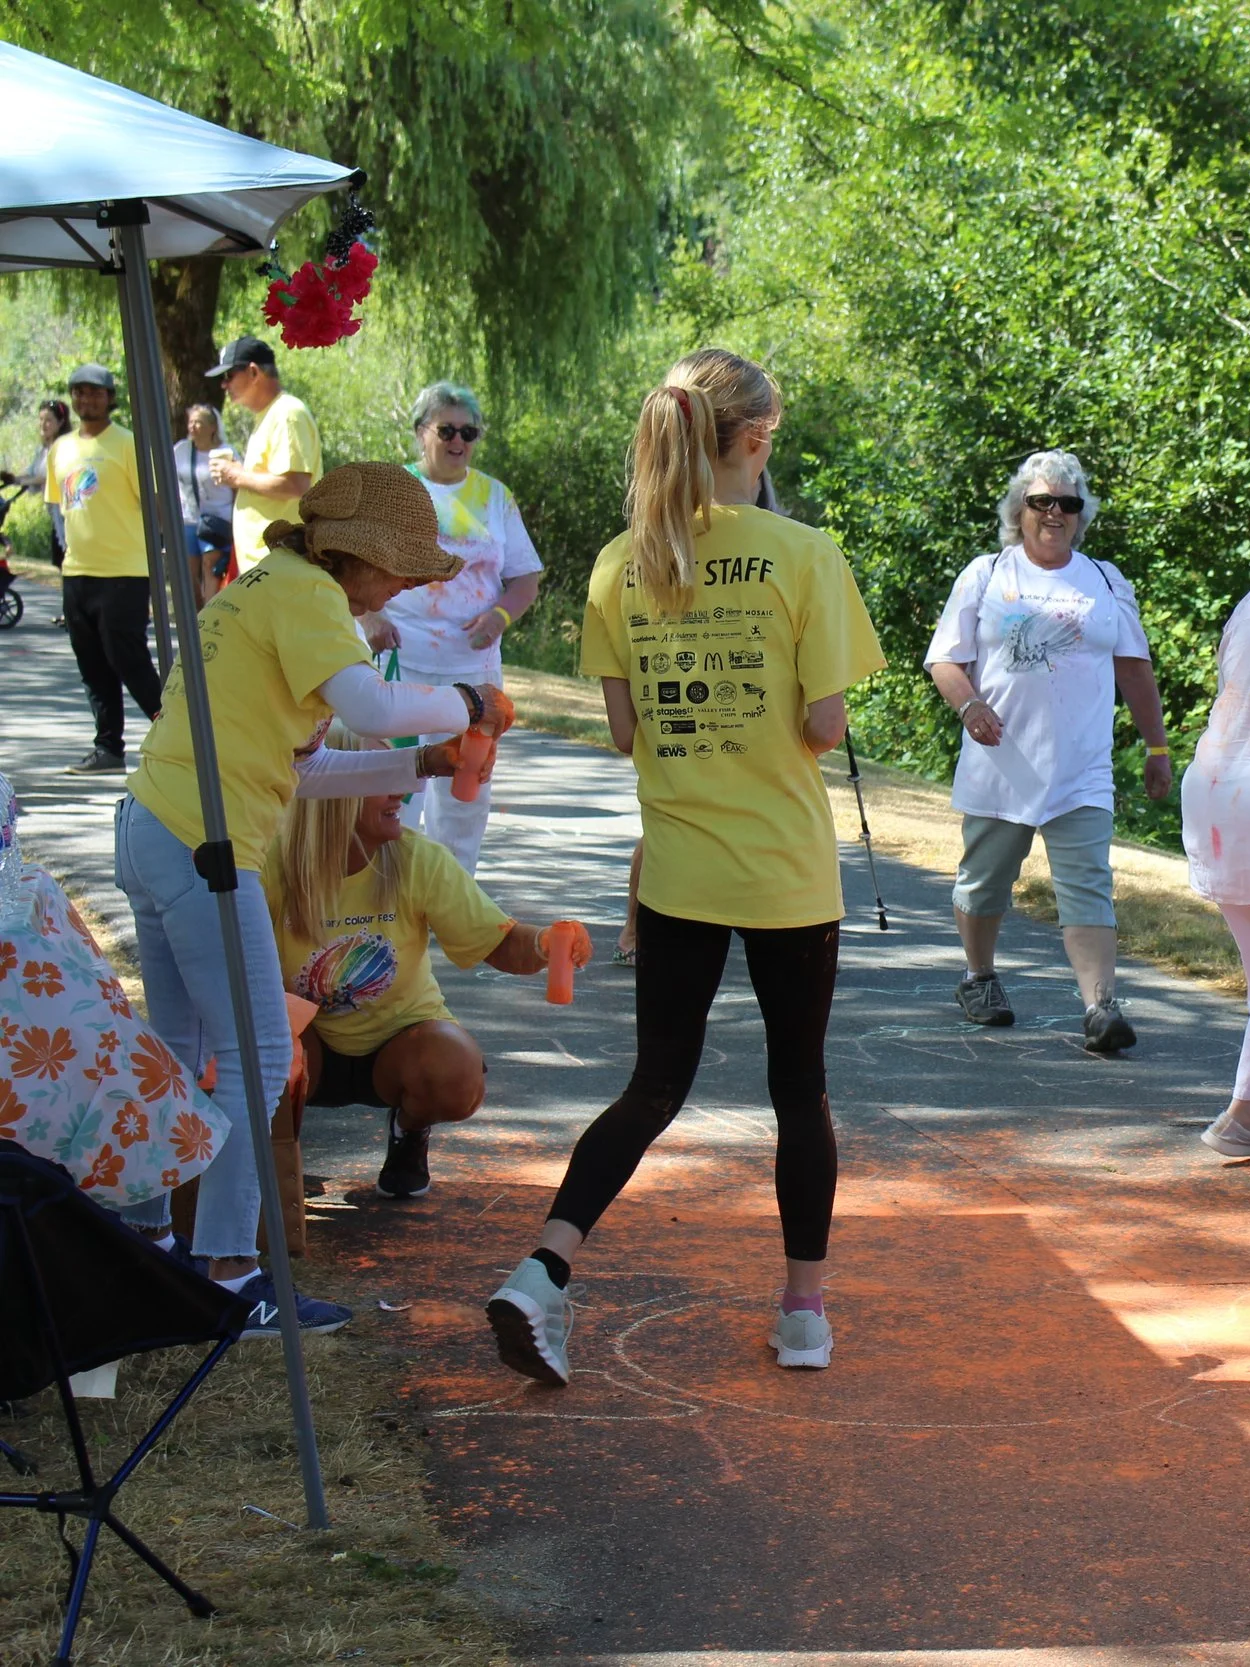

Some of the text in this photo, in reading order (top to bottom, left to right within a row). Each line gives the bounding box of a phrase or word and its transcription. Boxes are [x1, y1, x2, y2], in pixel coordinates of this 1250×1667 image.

[704, 557, 774, 586] STAFF
[657, 707, 688, 717] staples
[657, 747, 687, 757] NEWS
[721, 744, 742, 753] PEAK
